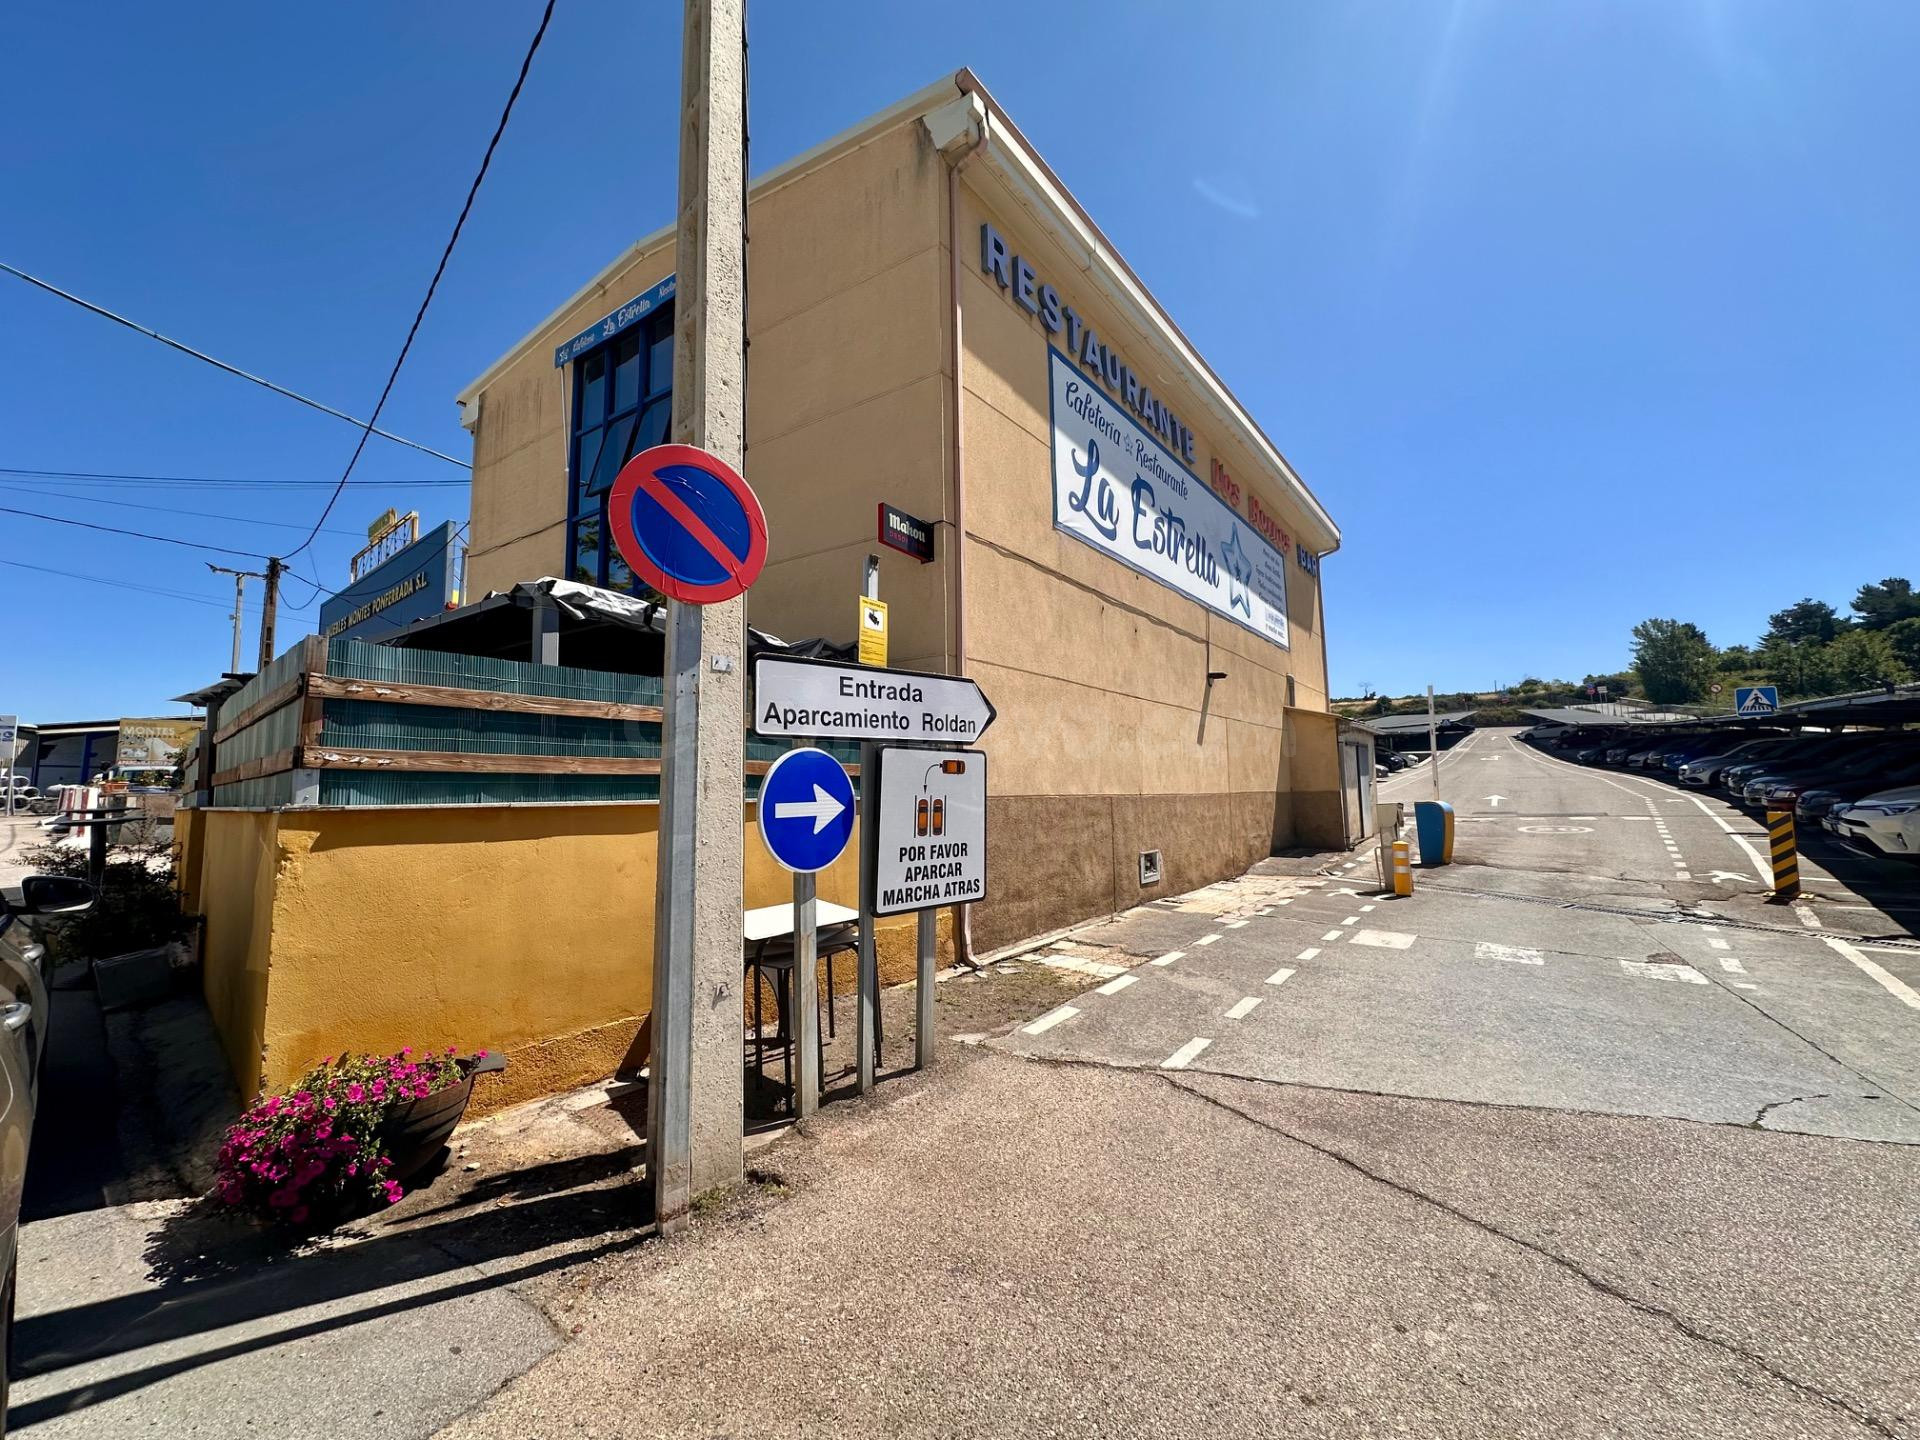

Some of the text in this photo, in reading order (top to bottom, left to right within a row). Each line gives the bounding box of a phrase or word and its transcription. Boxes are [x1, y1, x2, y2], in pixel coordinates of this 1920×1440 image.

[617, 299, 651, 328] Estrella
[980, 223, 1196, 464] RESTAURANTE
[1135, 438, 1188, 501] Restaurante
[888, 512, 926, 543] Mahou
[1068, 438, 1220, 588] La Estrella
[348, 602, 371, 628] MONTES
[372, 579, 414, 614] PONFERRADA
[839, 676, 923, 703] Entrada
[124, 726, 176, 737] MONTES
[763, 701, 976, 734] Aparcamiento Roldan
[899, 842, 968, 863] POR FAVOR
[904, 862, 963, 883] APARCAR
[882, 879, 980, 906] MARCHA ATRAS
